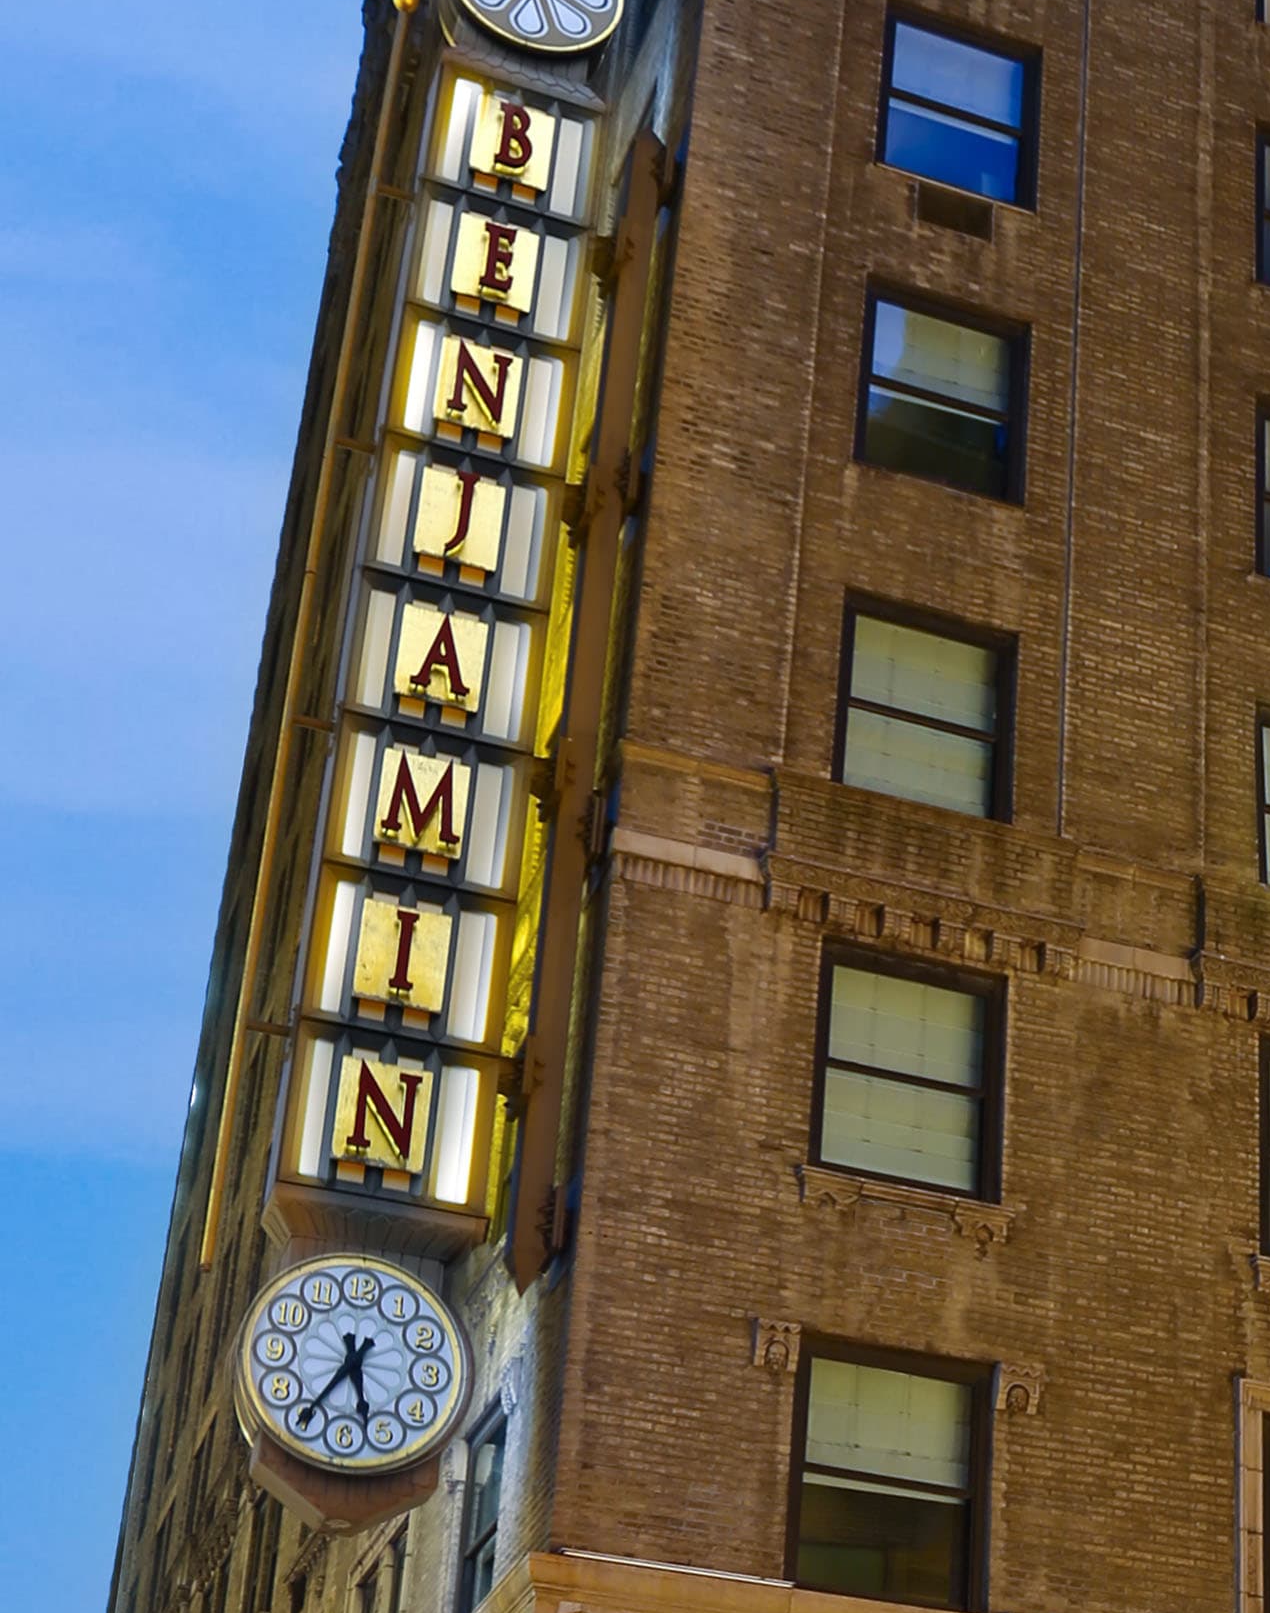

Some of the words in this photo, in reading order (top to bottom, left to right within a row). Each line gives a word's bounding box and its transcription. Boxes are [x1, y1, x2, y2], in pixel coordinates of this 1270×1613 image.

[346, 101, 533, 1157] BENJAMIN
[312, 1280, 333, 1305] 11
[349, 1276, 377, 1302] 12
[278, 1301, 304, 1326] 10
[393, 1295, 406, 1318] 1
[265, 1337, 284, 1360] 9
[415, 1325, 434, 1350] 2
[421, 1364, 439, 1387] 3
[271, 1376, 290, 1400] 8
[408, 1399, 425, 1423] 4
[335, 1425, 354, 1447] 6
[373, 1420, 393, 1444] 5
